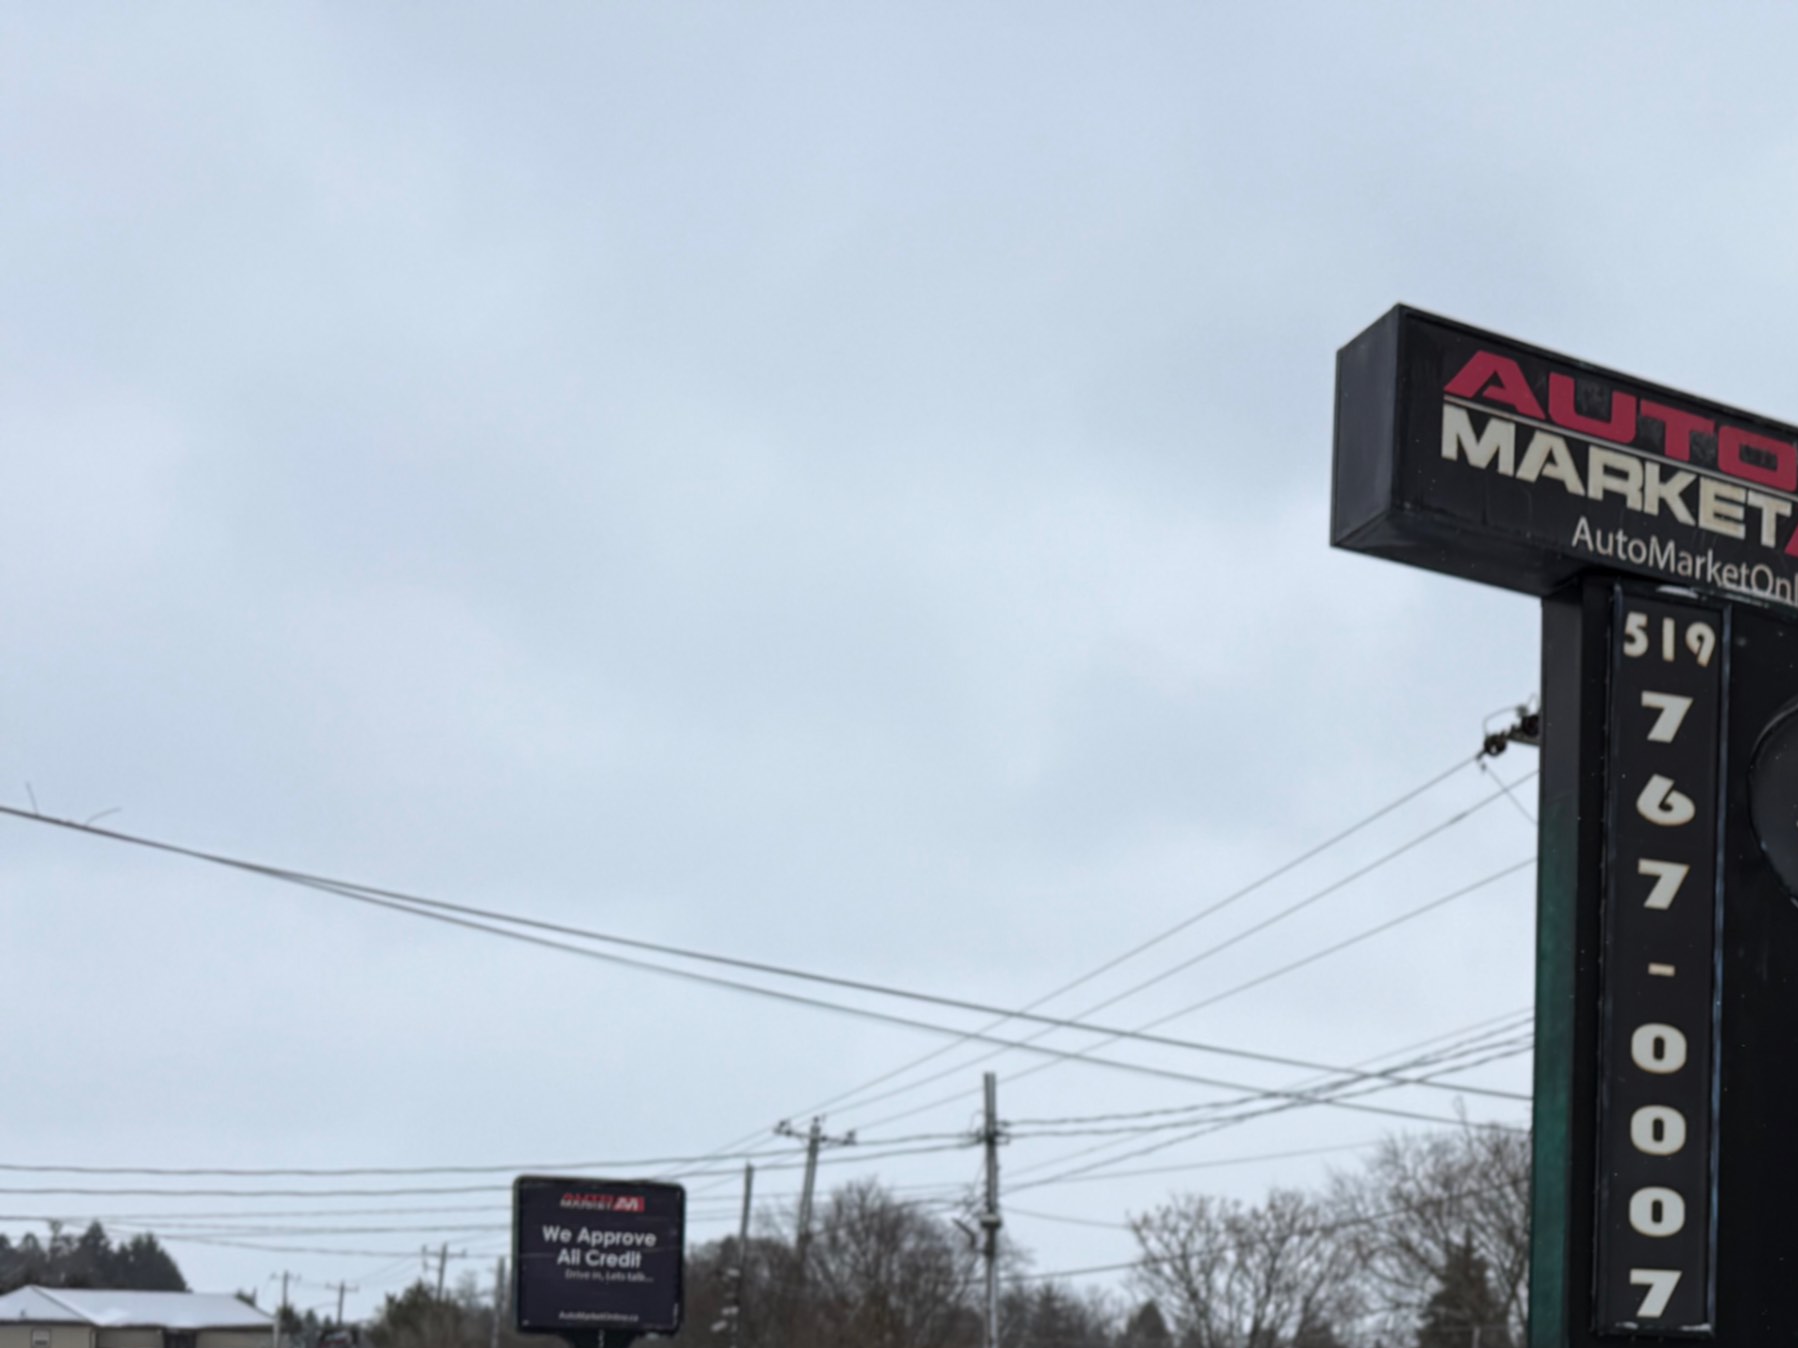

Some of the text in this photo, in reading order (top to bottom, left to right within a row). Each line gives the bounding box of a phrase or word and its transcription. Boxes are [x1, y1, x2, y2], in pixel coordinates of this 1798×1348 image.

[1443, 350, 1798, 492] AUTO
[1442, 403, 1792, 549] MARKET
[1623, 613, 1716, 667] 519
[542, 1225, 657, 1248] We Approve
[557, 1248, 642, 1269] All Credit
